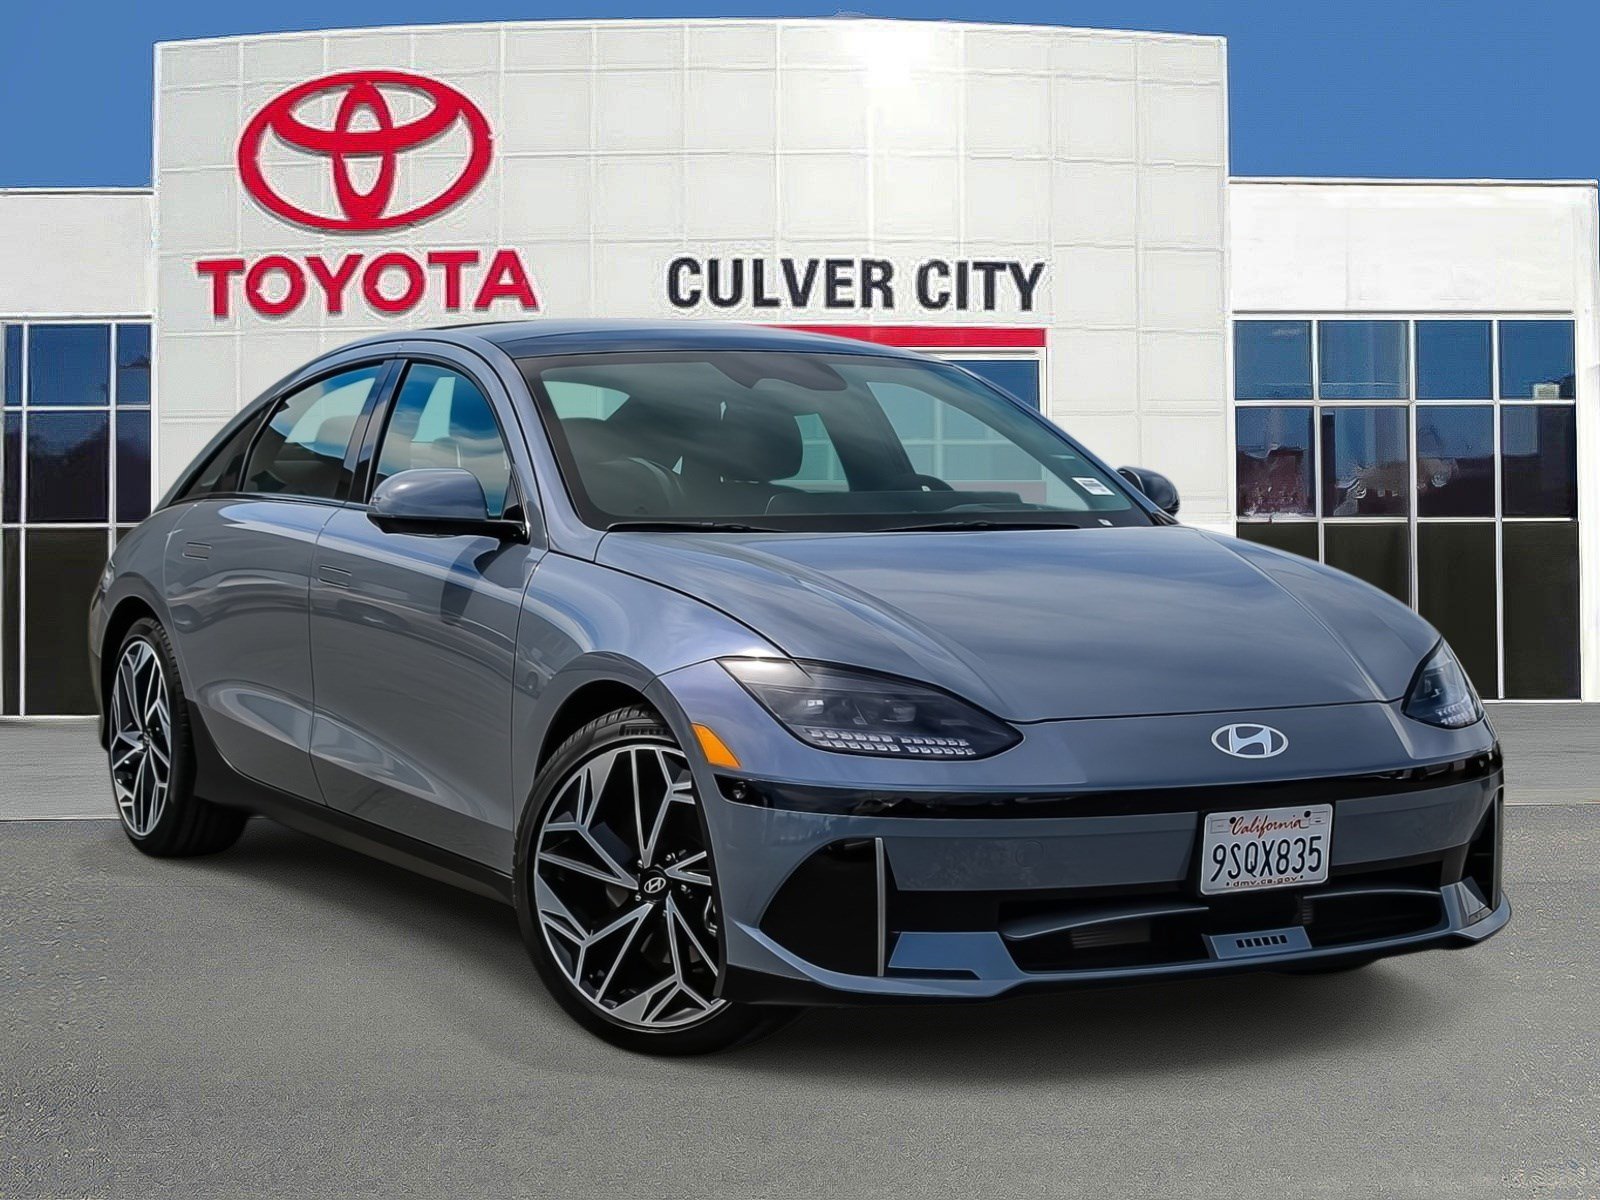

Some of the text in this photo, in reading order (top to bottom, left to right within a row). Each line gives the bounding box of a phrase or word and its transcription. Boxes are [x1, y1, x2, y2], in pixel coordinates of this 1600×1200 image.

[196, 250, 539, 318] TOYOTA
[667, 258, 1046, 311] CULVER CITY
[1231, 814, 1310, 839] California
[1210, 836, 1322, 882] 9SQX835
[1232, 876, 1299, 888] dmv.ca.gov
